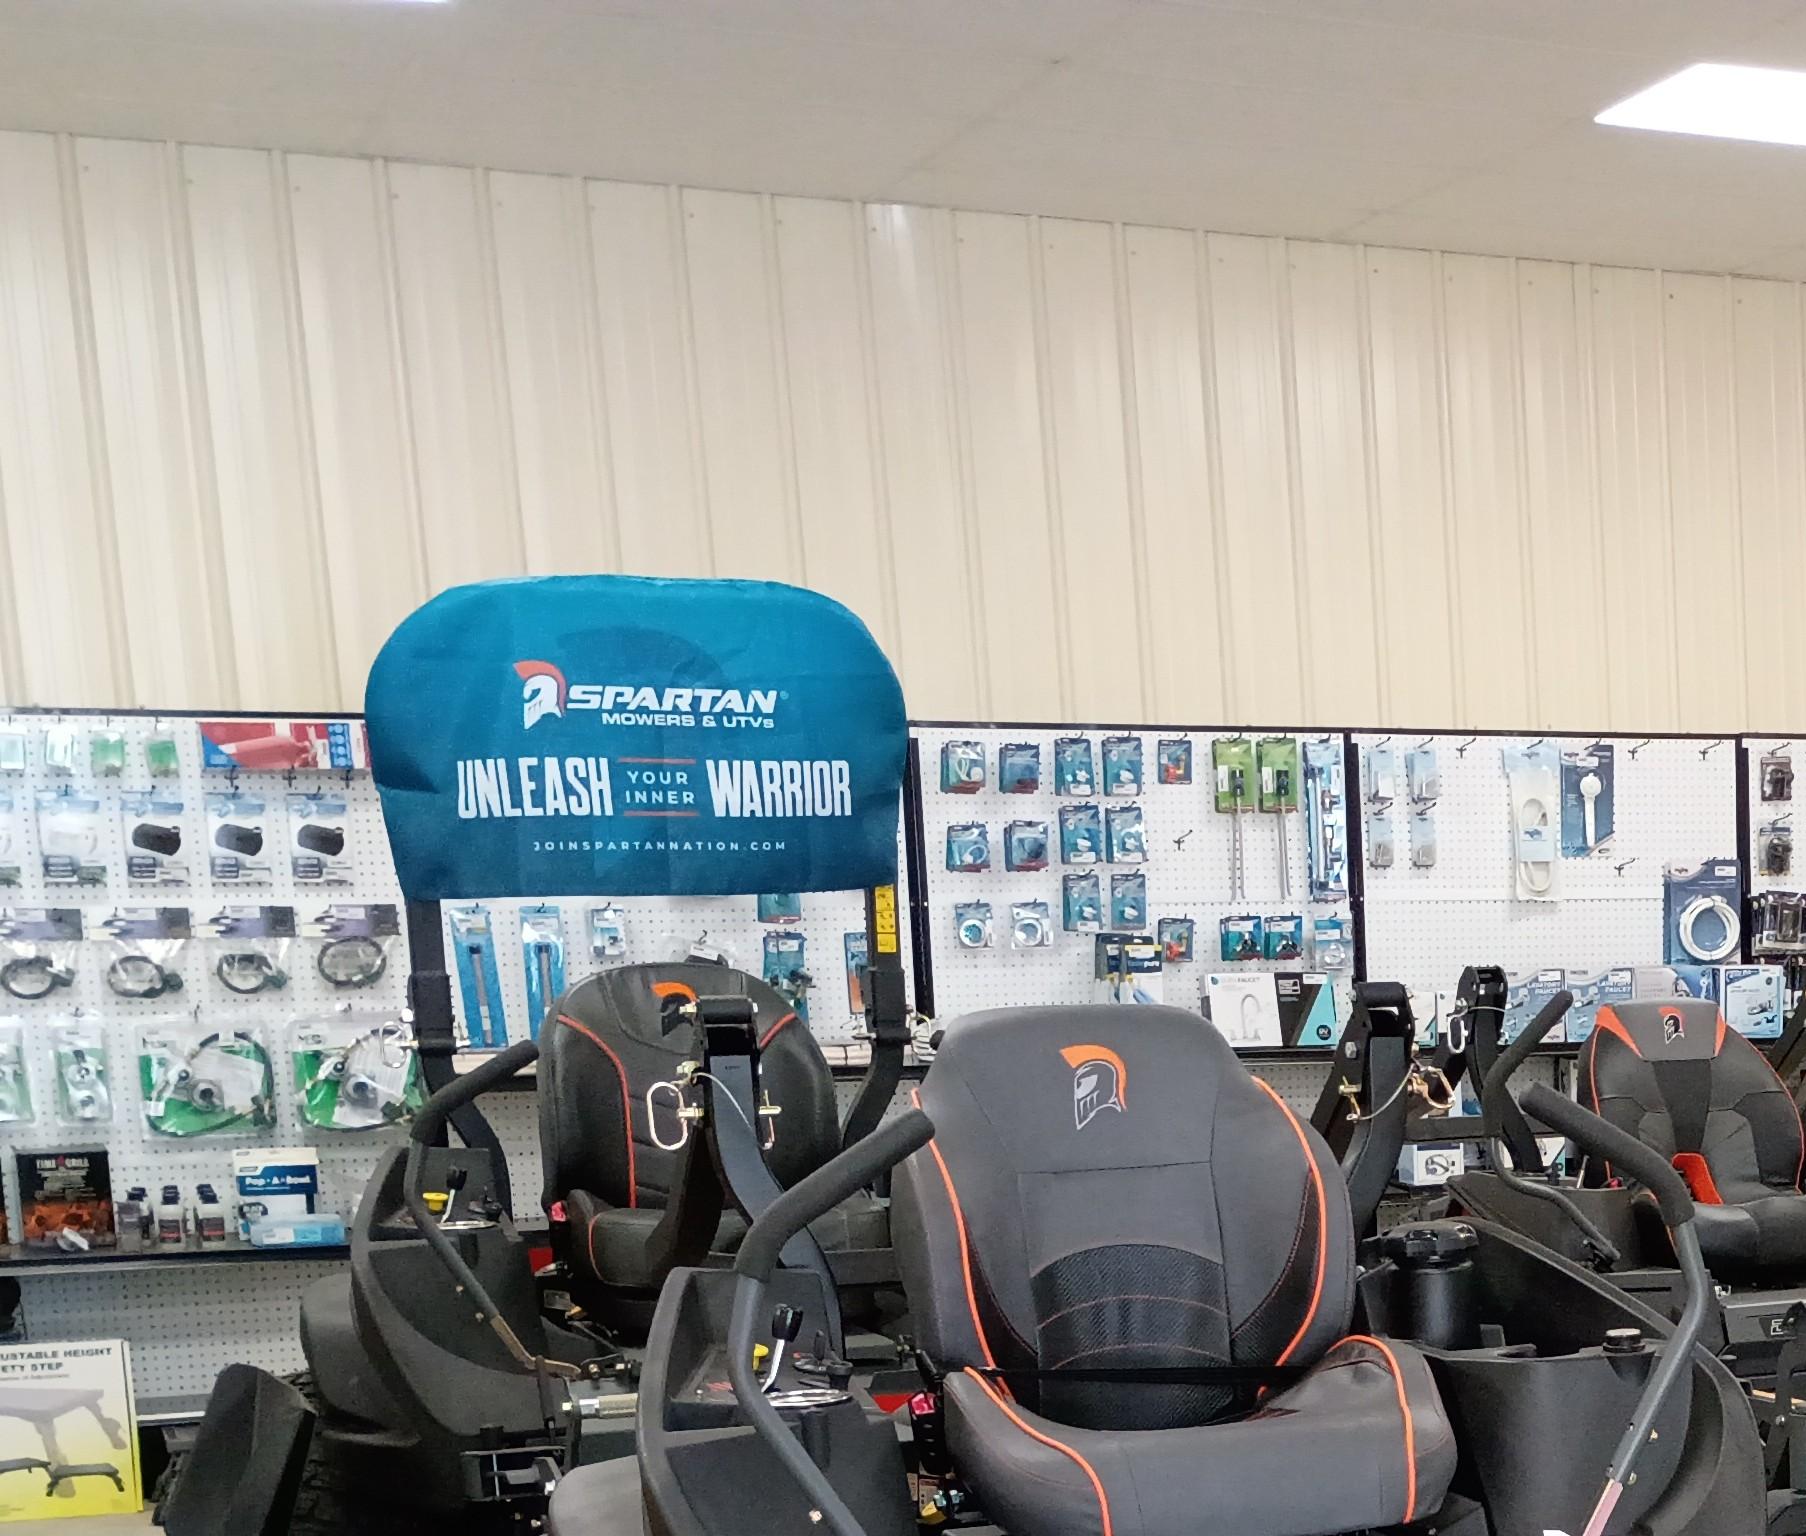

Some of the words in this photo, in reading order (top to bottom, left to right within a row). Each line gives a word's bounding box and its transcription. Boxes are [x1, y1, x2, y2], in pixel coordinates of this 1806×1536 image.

[566, 685, 777, 714] SPARTAN
[602, 712, 695, 727] MOWERS
[702, 715, 714, 727] &
[723, 716, 774, 729] UTVs
[626, 770, 690, 785] YOUR
[456, 756, 614, 819] UNLEASH
[706, 759, 852, 817] WARRIOR
[625, 790, 696, 805] INNER
[533, 840, 786, 851] JOINSPARTANNATION.COM
[63, 1347, 112, 1358] HEIGHT
[31, 1362, 63, 1372] STEP
